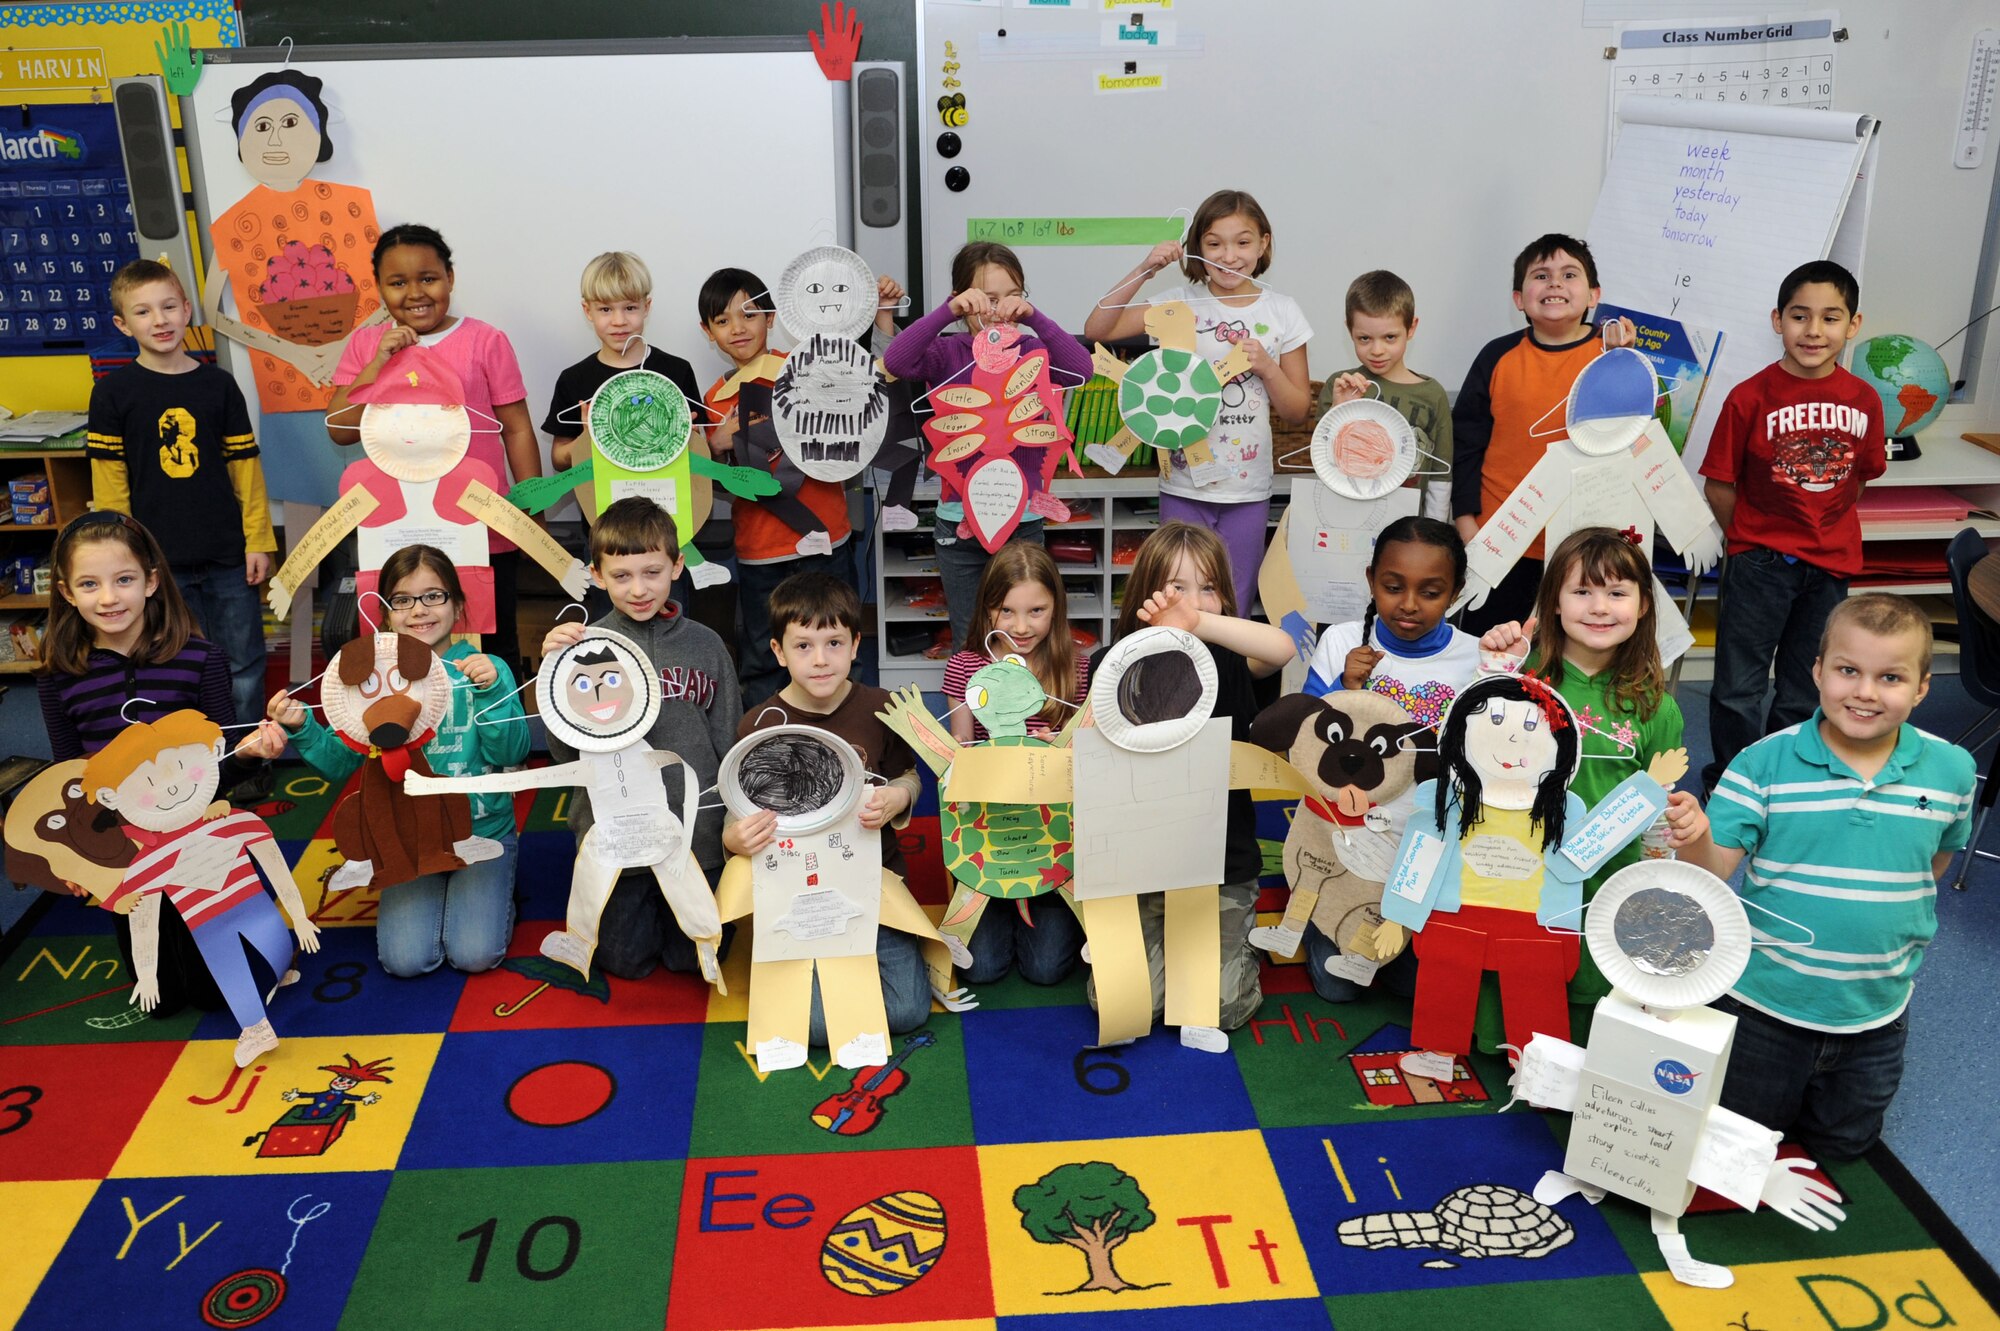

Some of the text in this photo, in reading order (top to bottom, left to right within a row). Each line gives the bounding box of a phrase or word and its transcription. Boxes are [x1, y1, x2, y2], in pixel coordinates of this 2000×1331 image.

[1120, 25, 1157, 45] today
[1663, 25, 1792, 43] Class Number Grid
[18, 57, 102, 80] HARVIN
[170, 66, 185, 79] left
[1622, 74, 1637, 86] -9
[1645, 74, 1660, 85] -8
[1668, 73, 1683, 84] -7
[1690, 72, 1705, 83] -6
[1713, 71, 1727, 82] -5
[1735, 70, 1750, 81] -4
[1757, 69, 1770, 80] -3
[1776, 67, 1789, 78] -2
[1797, 65, 1808, 76] -1
[1100, 75, 1159, 89] tomorrow
[1740, 91, 1747, 101] 6
[1762, 89, 1769, 100] 7
[1781, 87, 1788, 98] 8
[1802, 86, 1809, 97] 9
[1818, 84, 1830, 95] 10
[1687, 140, 1731, 161] week
[1680, 160, 1725, 183] month
[1673, 181, 1740, 212] yesterday
[66, 205, 75, 217] 2
[97, 204, 105, 216] 3
[1675, 202, 1709, 231] today
[11, 234, 18, 246] 7
[40, 234, 48, 246] 8
[72, 234, 79, 246] 9
[98, 232, 112, 245] 10
[1662, 220, 1717, 247] tomorrow
[13, 260, 115, 274] 14 15 16 17
[20, 289, 91, 302] 21 22 23
[25, 319, 39, 331] 28
[53, 318, 67, 330] 29
[82, 317, 96, 329] 30
[1639, 325, 1671, 341] Country
[1645, 339, 1662, 350] Ago
[1004, 357, 1044, 397] Adventurous
[944, 391, 972, 404] Little
[1015, 397, 1042, 420] Curio
[1219, 414, 1256, 425] Kitty
[1766, 402, 1868, 441] FREEDOM
[1025, 427, 1055, 439] Strong
[946, 443, 971, 456] Insect
[1566, 836, 1585, 853] Blue
[1581, 844, 1605, 862] nose
[1303, 851, 1336, 868] Physical
[1310, 860, 1332, 875] Traits
[998, 867, 1020, 876] Turtle
[1405, 871, 1419, 890] Fun
[17, 945, 119, 982] Nn
[310, 961, 369, 1003] 8
[1247, 1003, 1349, 1046] Hh
[1072, 1047, 1131, 1096] 6
[1656, 1067, 1692, 1088] NASA
[187, 1064, 268, 1115] Jj
[1591, 1083, 1623, 1106] Eileen
[0, 1084, 44, 1136] 3
[1586, 1134, 1615, 1154] strong
[1602, 1120, 1638, 1137] explore
[1649, 1137, 1673, 1152] lead
[1590, 1155, 1657, 1197] Eileen Collins
[700, 1170, 817, 1233] Ee
[116, 1195, 222, 1270] Yy
[457, 1214, 582, 1284] 10
[1176, 1214, 1282, 1290] Tt
[1795, 1271, 1959, 1331] Dd
